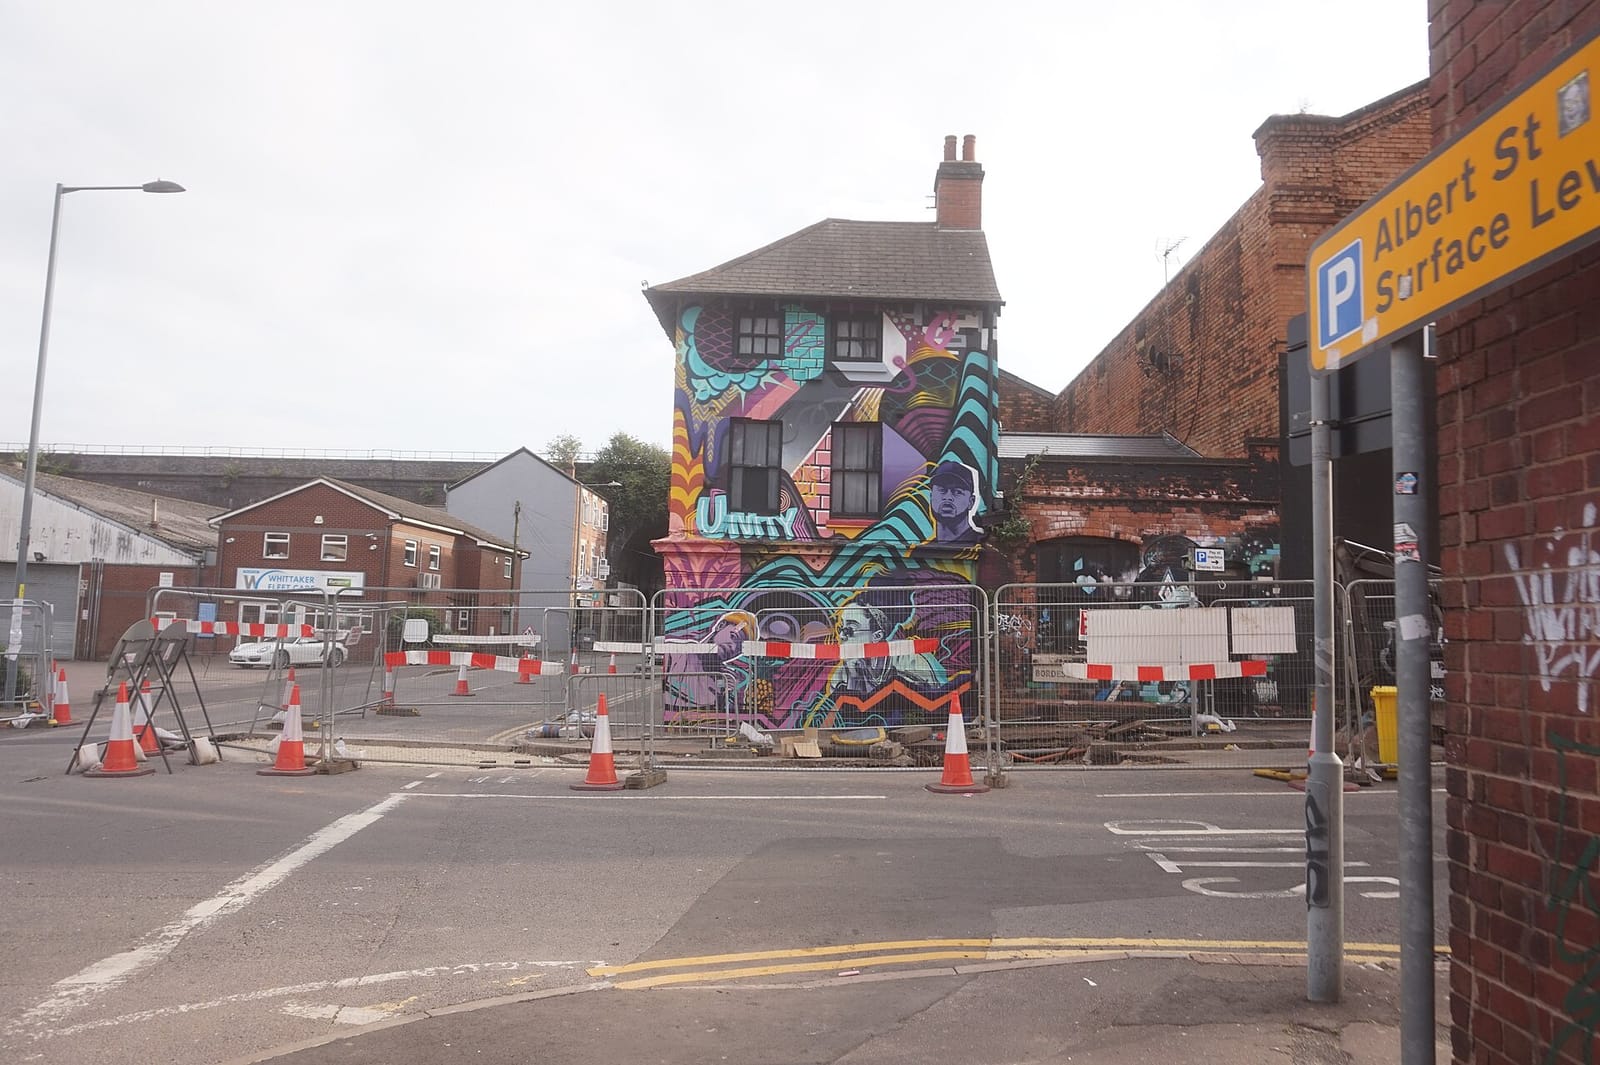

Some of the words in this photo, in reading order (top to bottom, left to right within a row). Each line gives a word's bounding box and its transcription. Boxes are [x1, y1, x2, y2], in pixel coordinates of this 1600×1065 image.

[1374, 159, 1476, 262] Albert
[1493, 113, 1542, 181] St
[1327, 257, 1356, 337] P
[696, 495, 798, 540] UNITY
[268, 575, 315, 584] WHITTAKER
